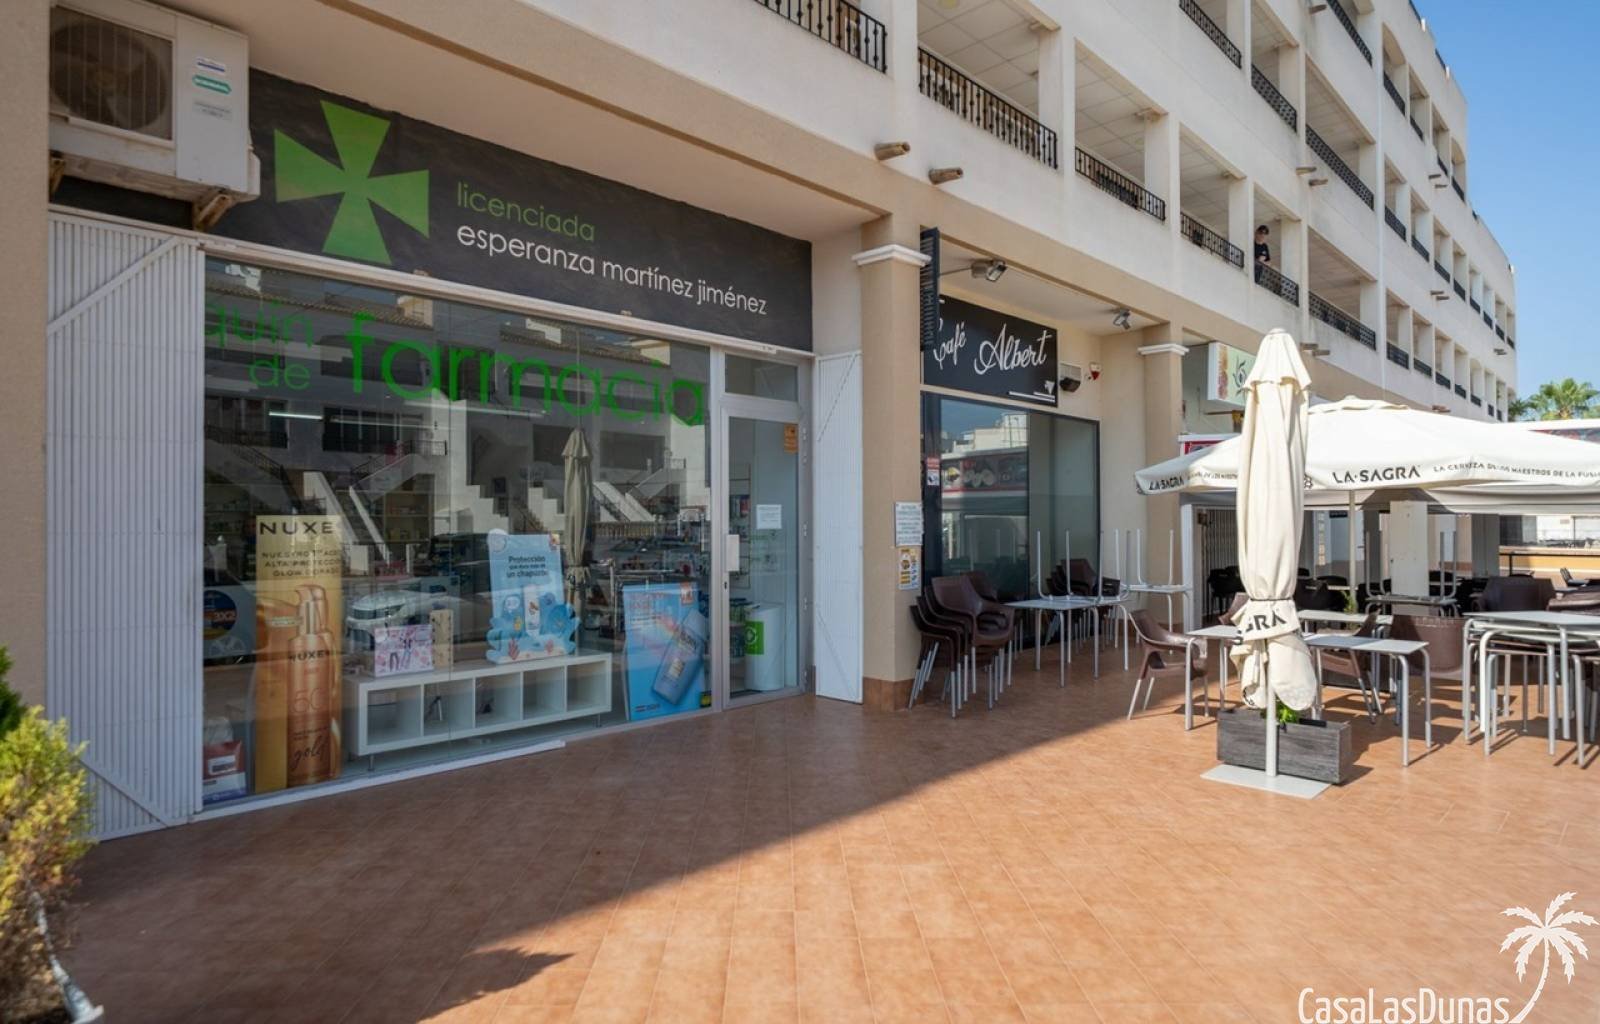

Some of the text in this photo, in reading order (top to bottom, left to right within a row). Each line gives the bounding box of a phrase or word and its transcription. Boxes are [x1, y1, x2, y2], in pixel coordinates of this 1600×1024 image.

[457, 181, 595, 243] licenciada
[456, 224, 768, 316] esperanza martínez jiménez
[250, 352, 312, 390] de
[345, 311, 706, 428] farmacia
[974, 322, 1053, 375] Albert
[260, 522, 333, 535] NUXE
